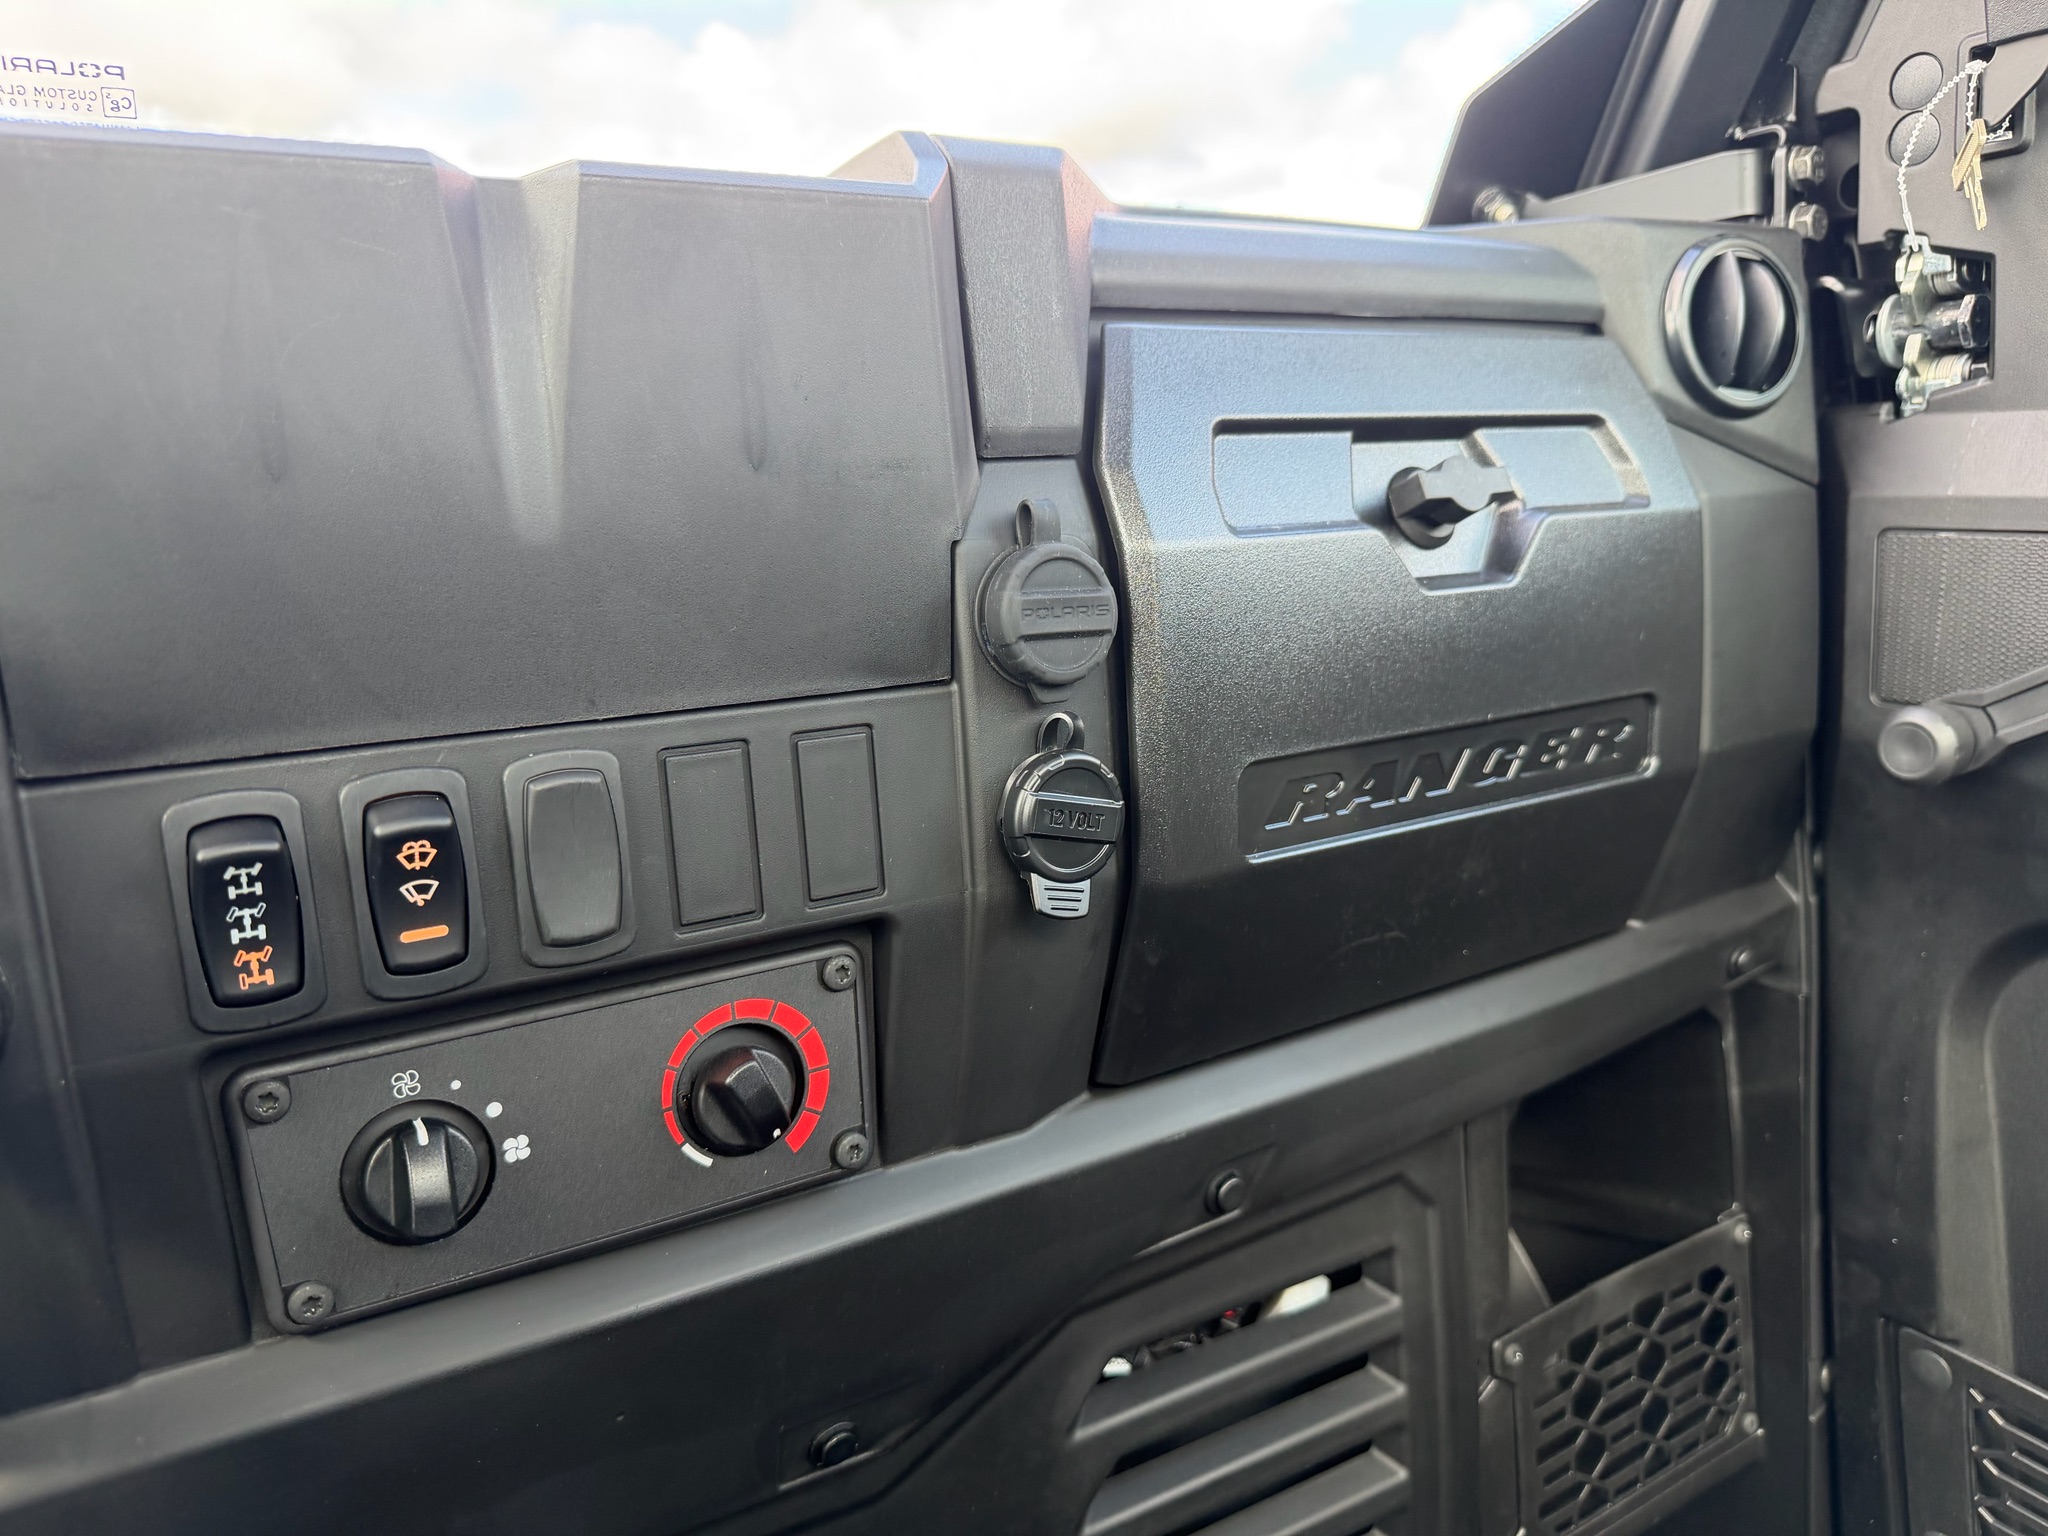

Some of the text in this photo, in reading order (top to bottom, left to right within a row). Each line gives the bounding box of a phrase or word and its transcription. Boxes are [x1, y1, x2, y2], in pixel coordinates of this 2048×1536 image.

[1021, 604, 1110, 620] POLARIS
[1264, 716, 1635, 830] RANGER
[1046, 808, 1106, 832] 12 VOLT
